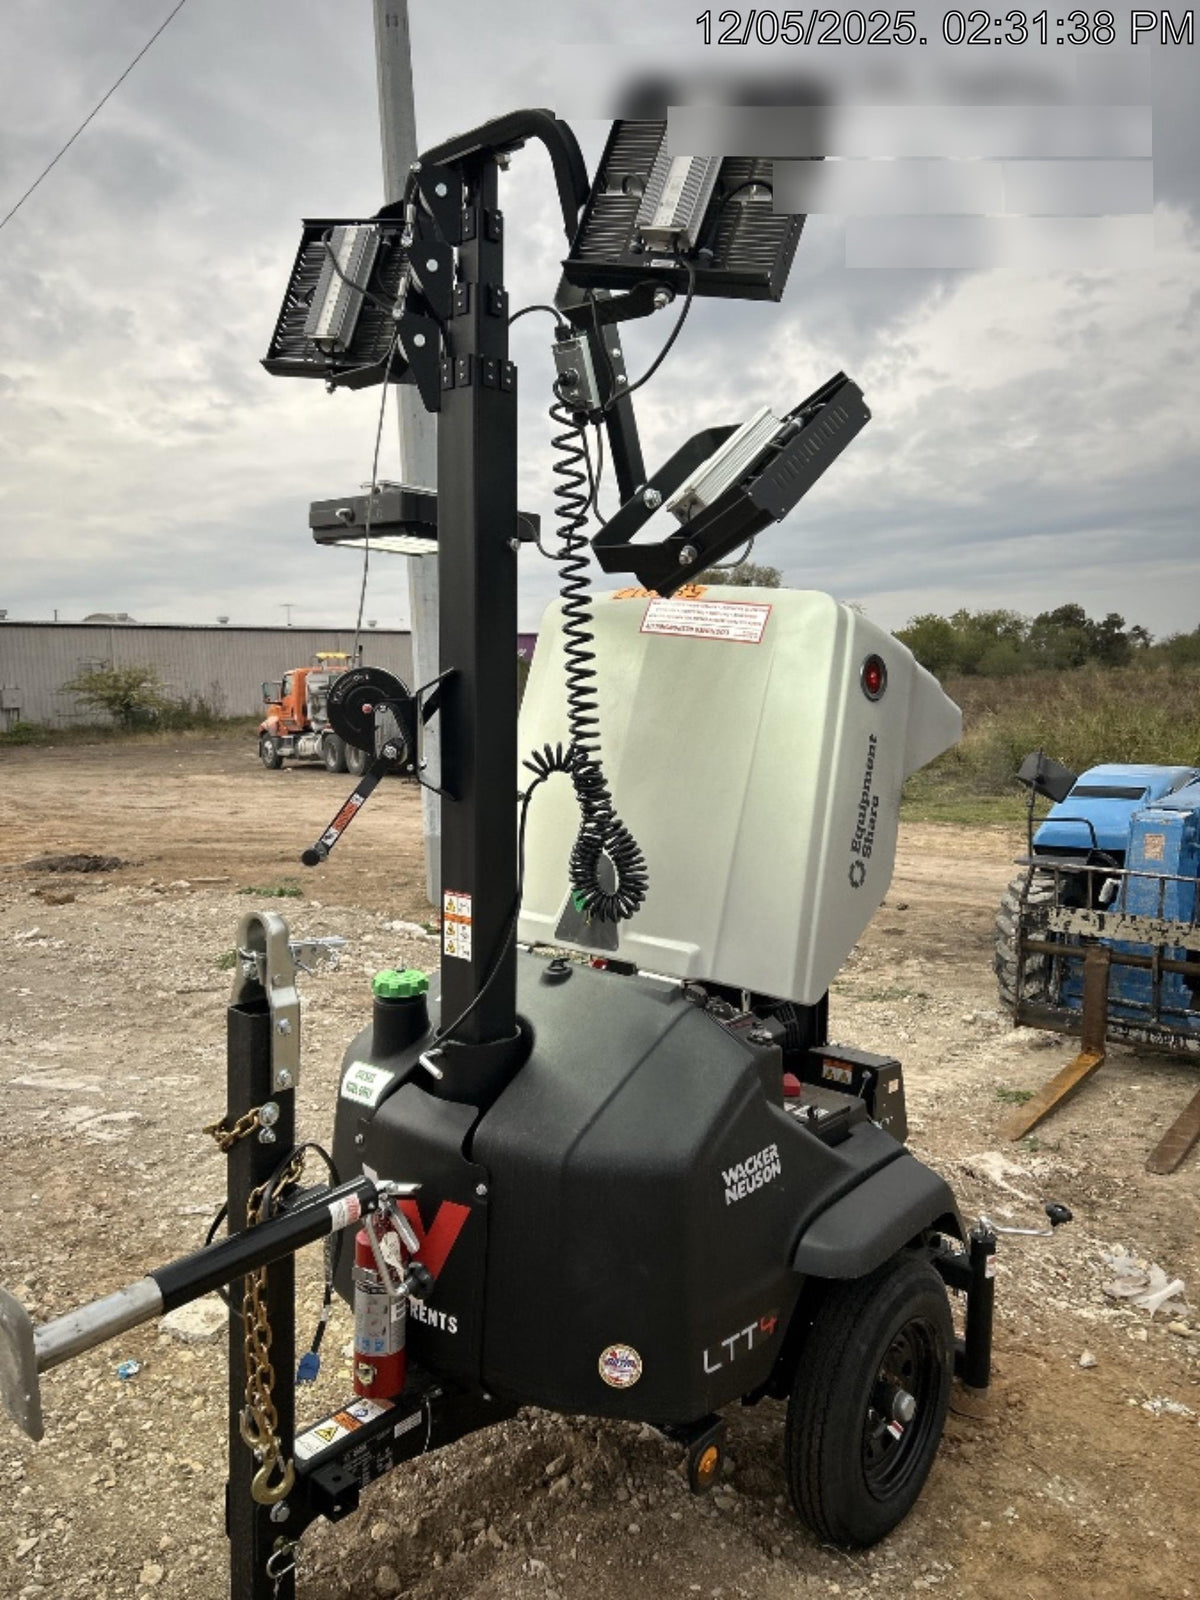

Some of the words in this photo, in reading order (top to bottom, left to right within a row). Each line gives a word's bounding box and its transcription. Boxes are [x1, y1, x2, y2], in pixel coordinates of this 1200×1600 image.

[850, 733, 877, 855] Equipment
[862, 796, 879, 859] Share
[721, 1143, 779, 1186] WACKER
[724, 1159, 781, 1205] NEUSON
[409, 1296, 458, 1334] RENTS
[703, 1315, 778, 1375] LTT4
